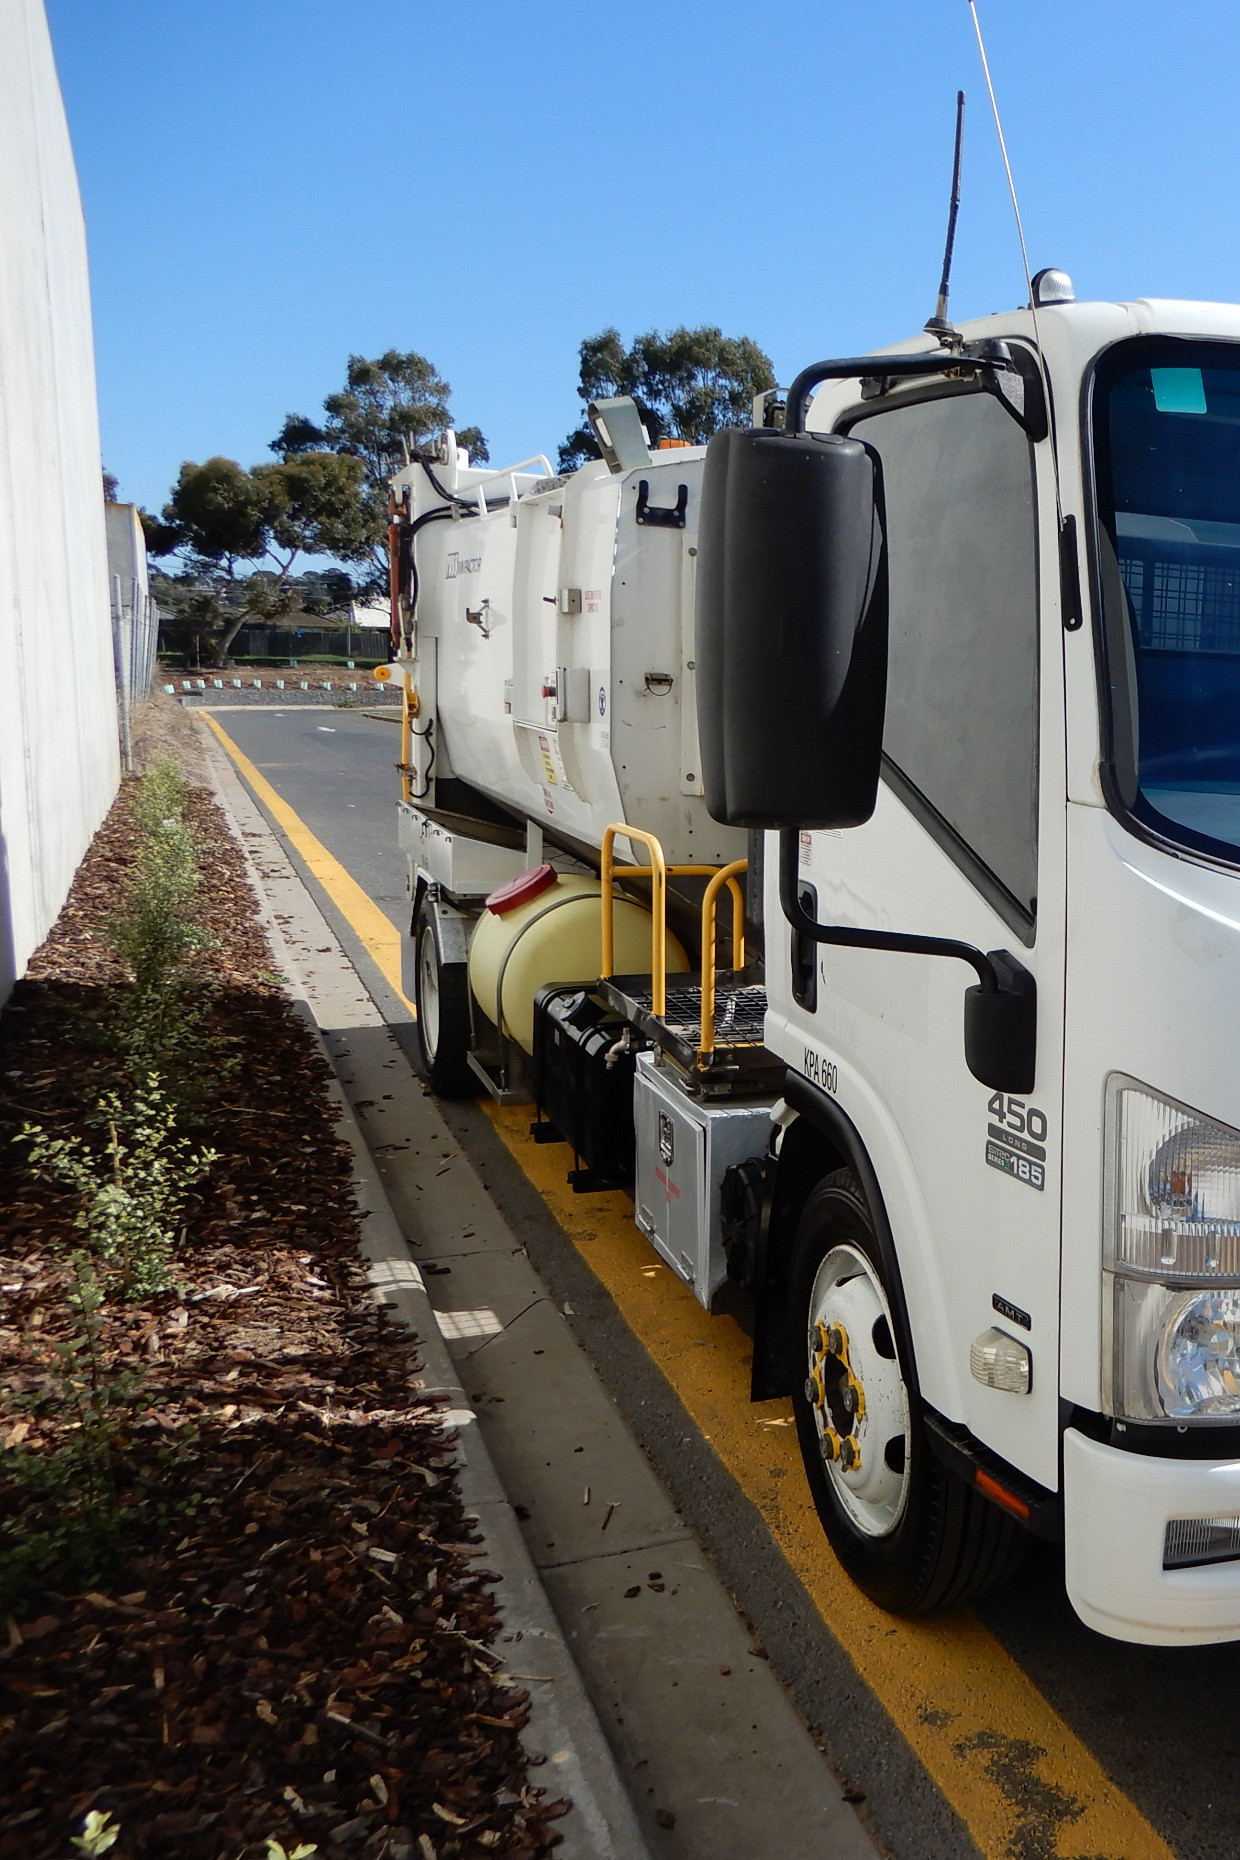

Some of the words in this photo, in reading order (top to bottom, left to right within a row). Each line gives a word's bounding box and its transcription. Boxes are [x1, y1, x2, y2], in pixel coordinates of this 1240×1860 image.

[804, 1046, 819, 1084] KPA
[821, 1058, 838, 1095] 660
[987, 1091, 1048, 1143] 450
[1001, 1133, 1028, 1151] LONG
[1009, 1155, 1043, 1186] 185
[996, 1301, 1023, 1323] AMT
